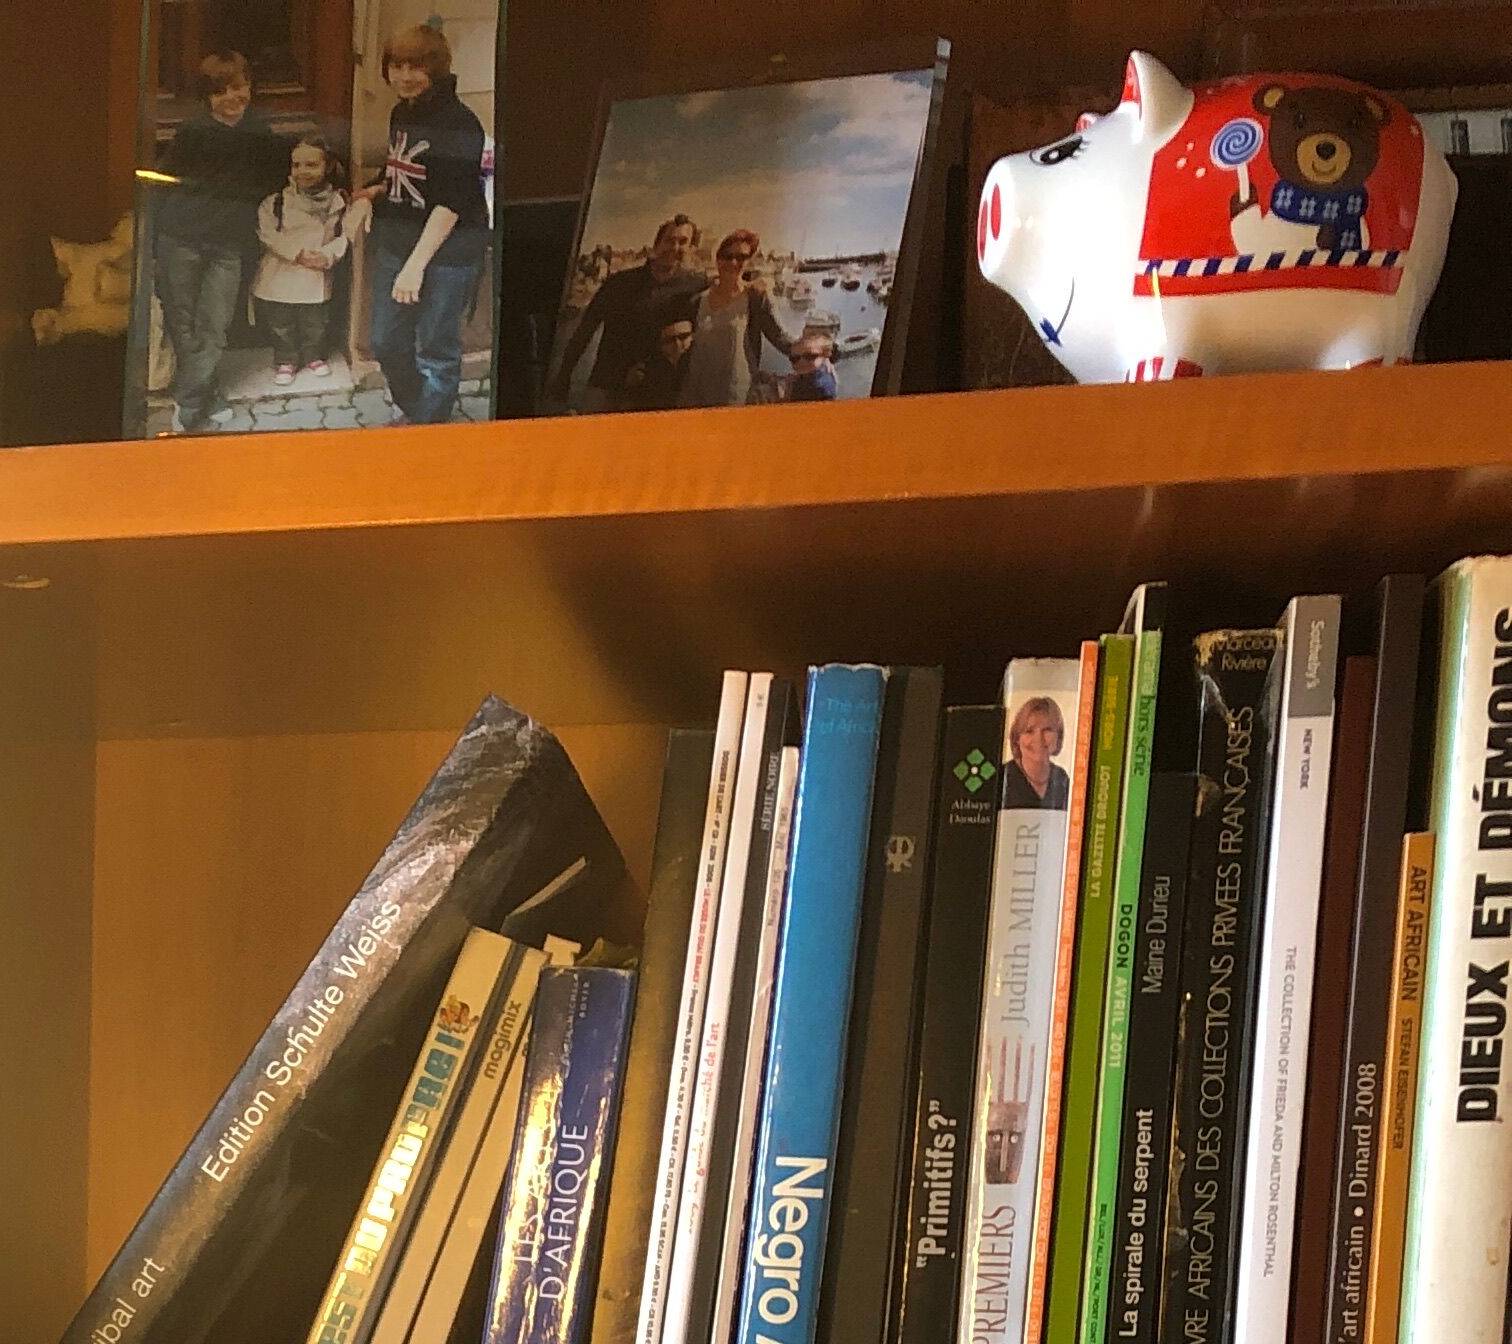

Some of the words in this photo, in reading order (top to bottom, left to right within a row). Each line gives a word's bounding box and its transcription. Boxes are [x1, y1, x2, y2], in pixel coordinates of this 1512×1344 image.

[1009, 821, 1041, 932] MILLER
[1145, 875, 1172, 932] Durieu
[1410, 864, 1428, 904] ART
[1470, 872, 1512, 940] ET
[1116, 903, 1133, 970] DOGON
[1140, 933, 1167, 994] Maine
[1285, 947, 1297, 972] THE
[1400, 911, 1428, 1002] AFRICAIN
[1000, 941, 1032, 1027] Judith
[1278, 973, 1296, 1056] COLLECTION
[483, 1000, 522, 1079] magimix
[1198, 952, 1236, 1121] COLLECTIONS
[1277, 1058, 1289, 1077] OF
[1455, 960, 1510, 1122] DIEUX
[132, 1257, 166, 1301] art
[201, 1089, 277, 1183] Edition
[265, 985, 345, 1087] Schulte
[333, 899, 402, 979] Weiss
[1355, 1061, 1377, 1119] 2008
[1132, 1107, 1155, 1191] serpent
[1272, 1124, 1284, 1151] AND
[1348, 1124, 1373, 1198] Dinard
[540, 1121, 590, 1301] D'AFRIQUE
[1128, 1193, 1147, 1227] du
[1268, 1153, 1282, 1202] MILTON
[753, 1156, 829, 1326] Negro
[1123, 1230, 1147, 1307] spirale
[1189, 1178, 1219, 1300] AFRICAINS
[1263, 1204, 1280, 1278] ROSENTHAL
[1339, 1225, 1366, 1301] africain
[1116, 1310, 1139, 1337] La
